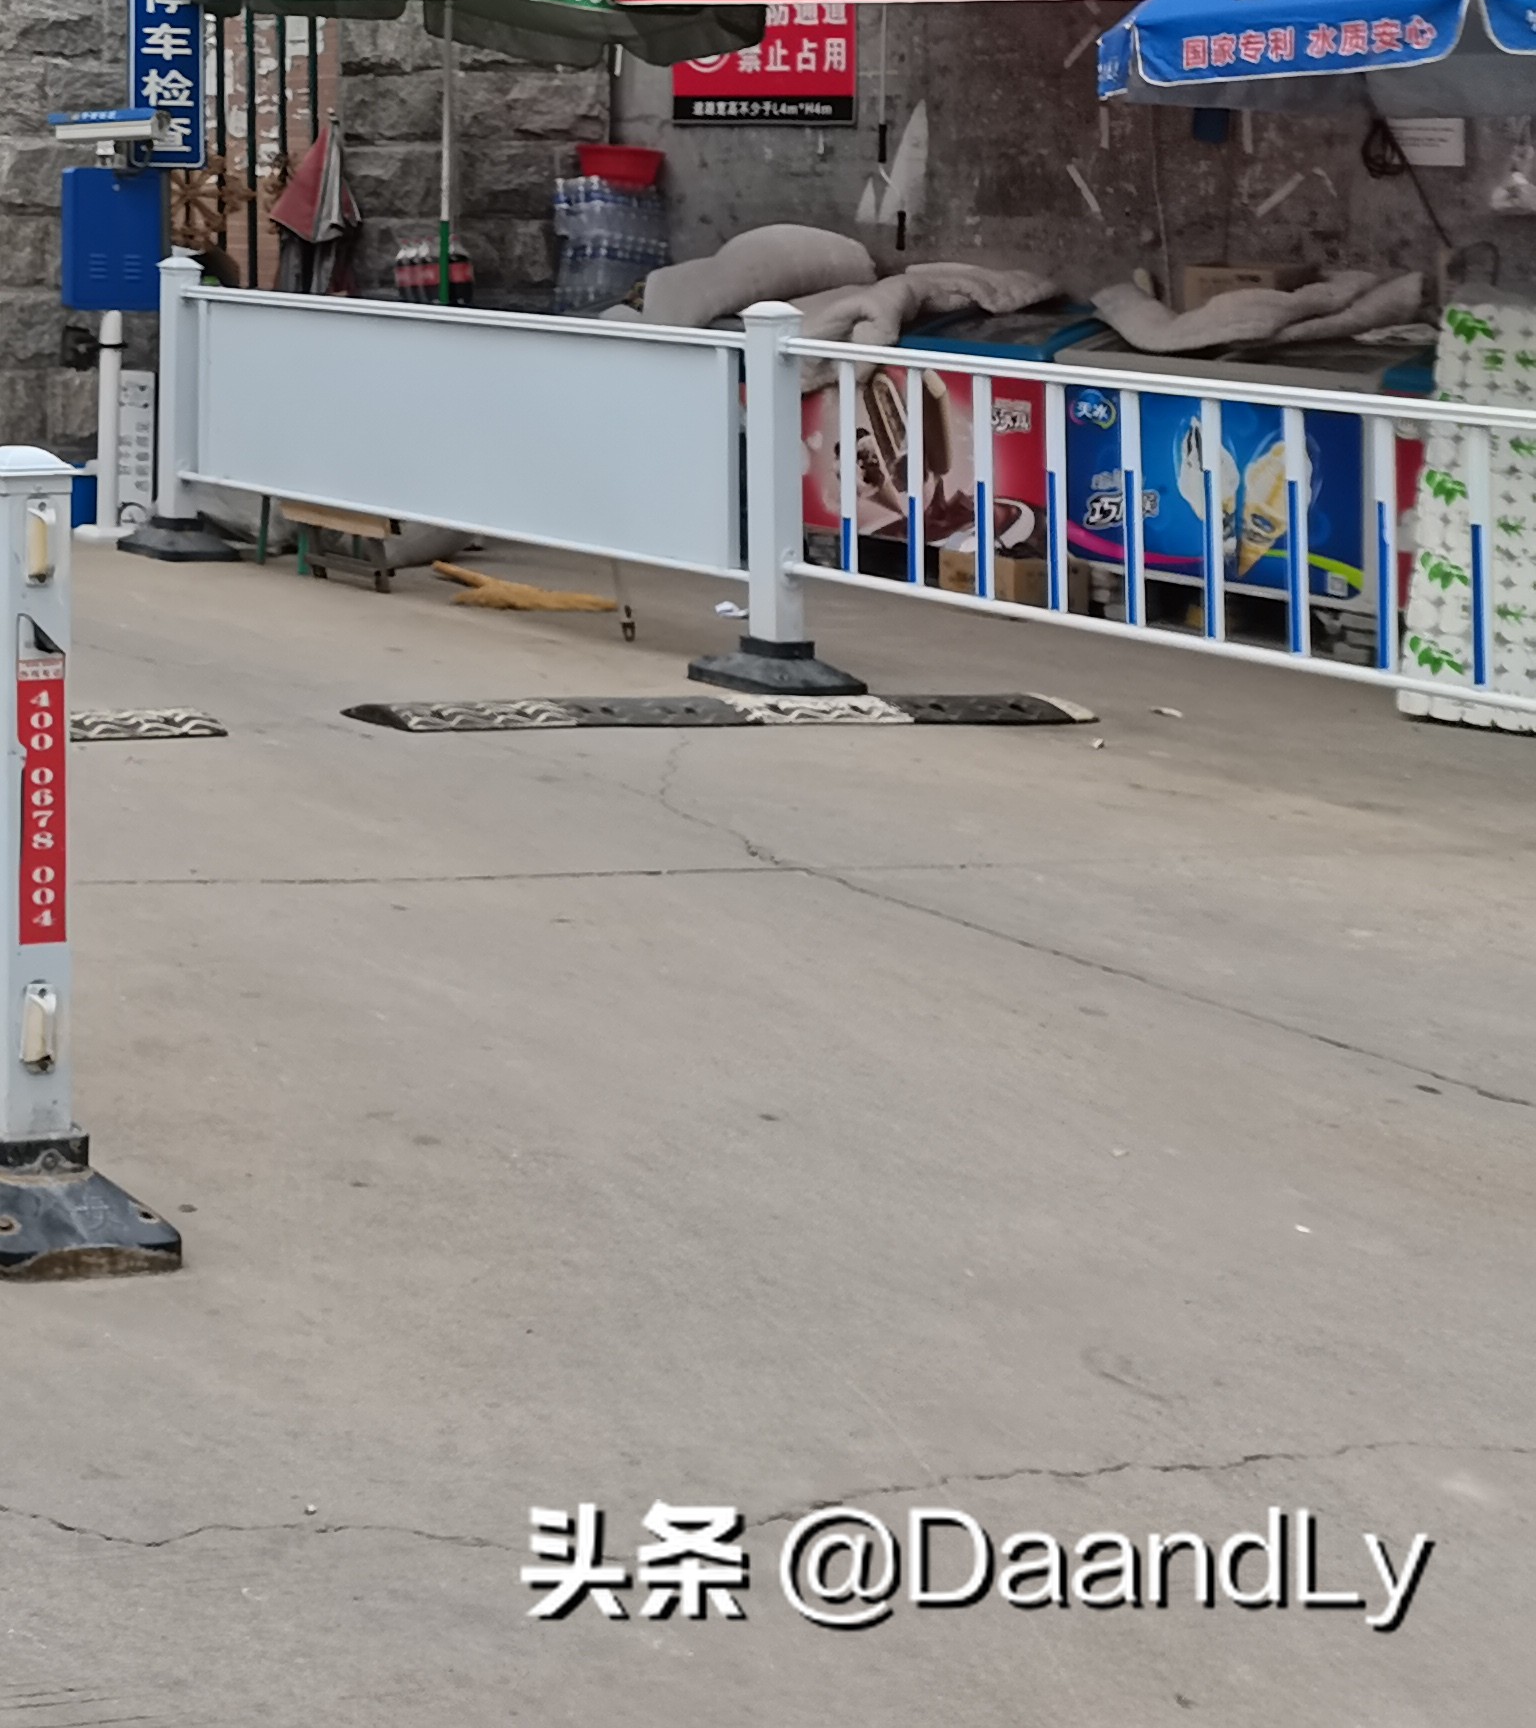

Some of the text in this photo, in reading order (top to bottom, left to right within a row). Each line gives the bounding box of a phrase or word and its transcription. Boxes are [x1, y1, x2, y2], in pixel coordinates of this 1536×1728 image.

[1181, 13, 1438, 72] 国家专利 水质安心
[29, 689, 54, 752] 400
[30, 766, 55, 851] 0678
[31, 864, 56, 927] 004
